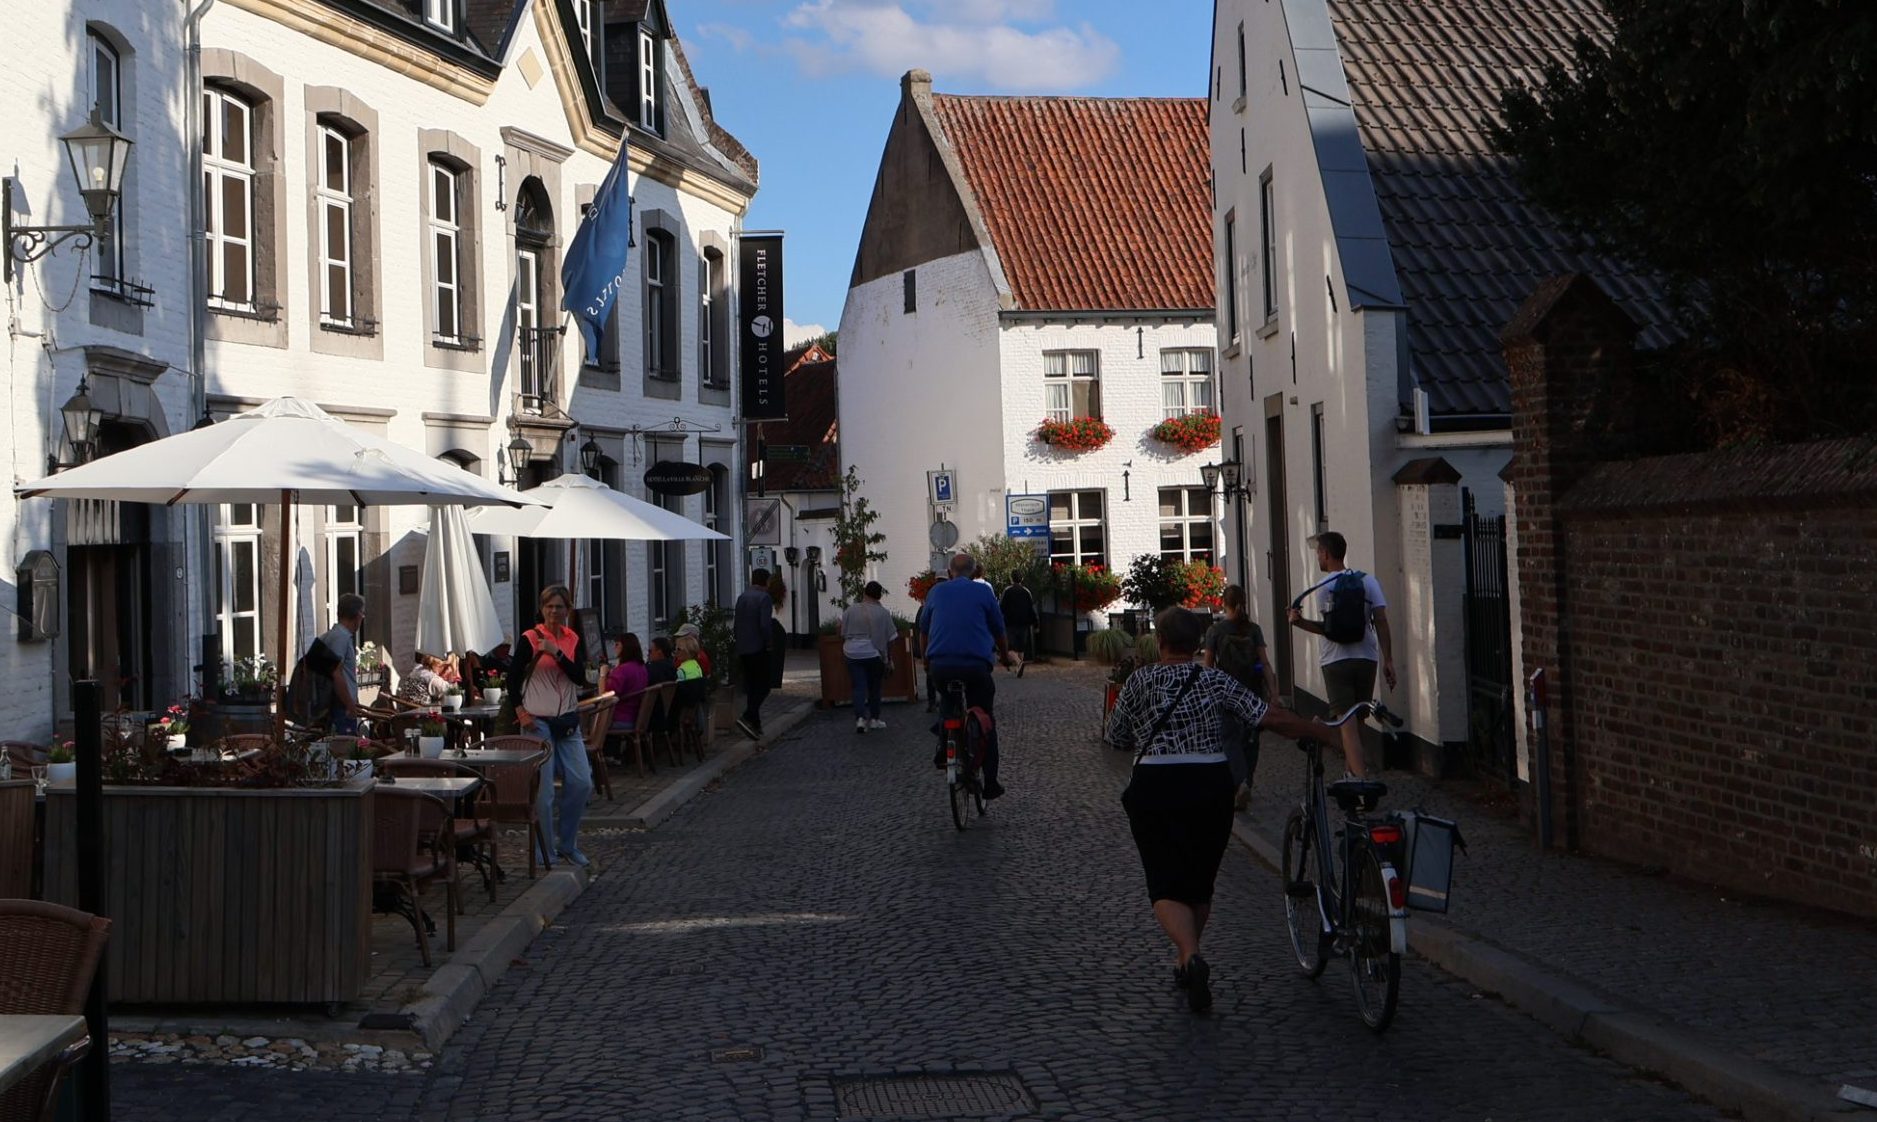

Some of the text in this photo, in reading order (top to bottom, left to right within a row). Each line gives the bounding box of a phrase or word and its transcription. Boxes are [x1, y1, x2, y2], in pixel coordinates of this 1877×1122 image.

[757, 249, 768, 405] FLETCHER HOTELS
[938, 479, 947, 493] P
